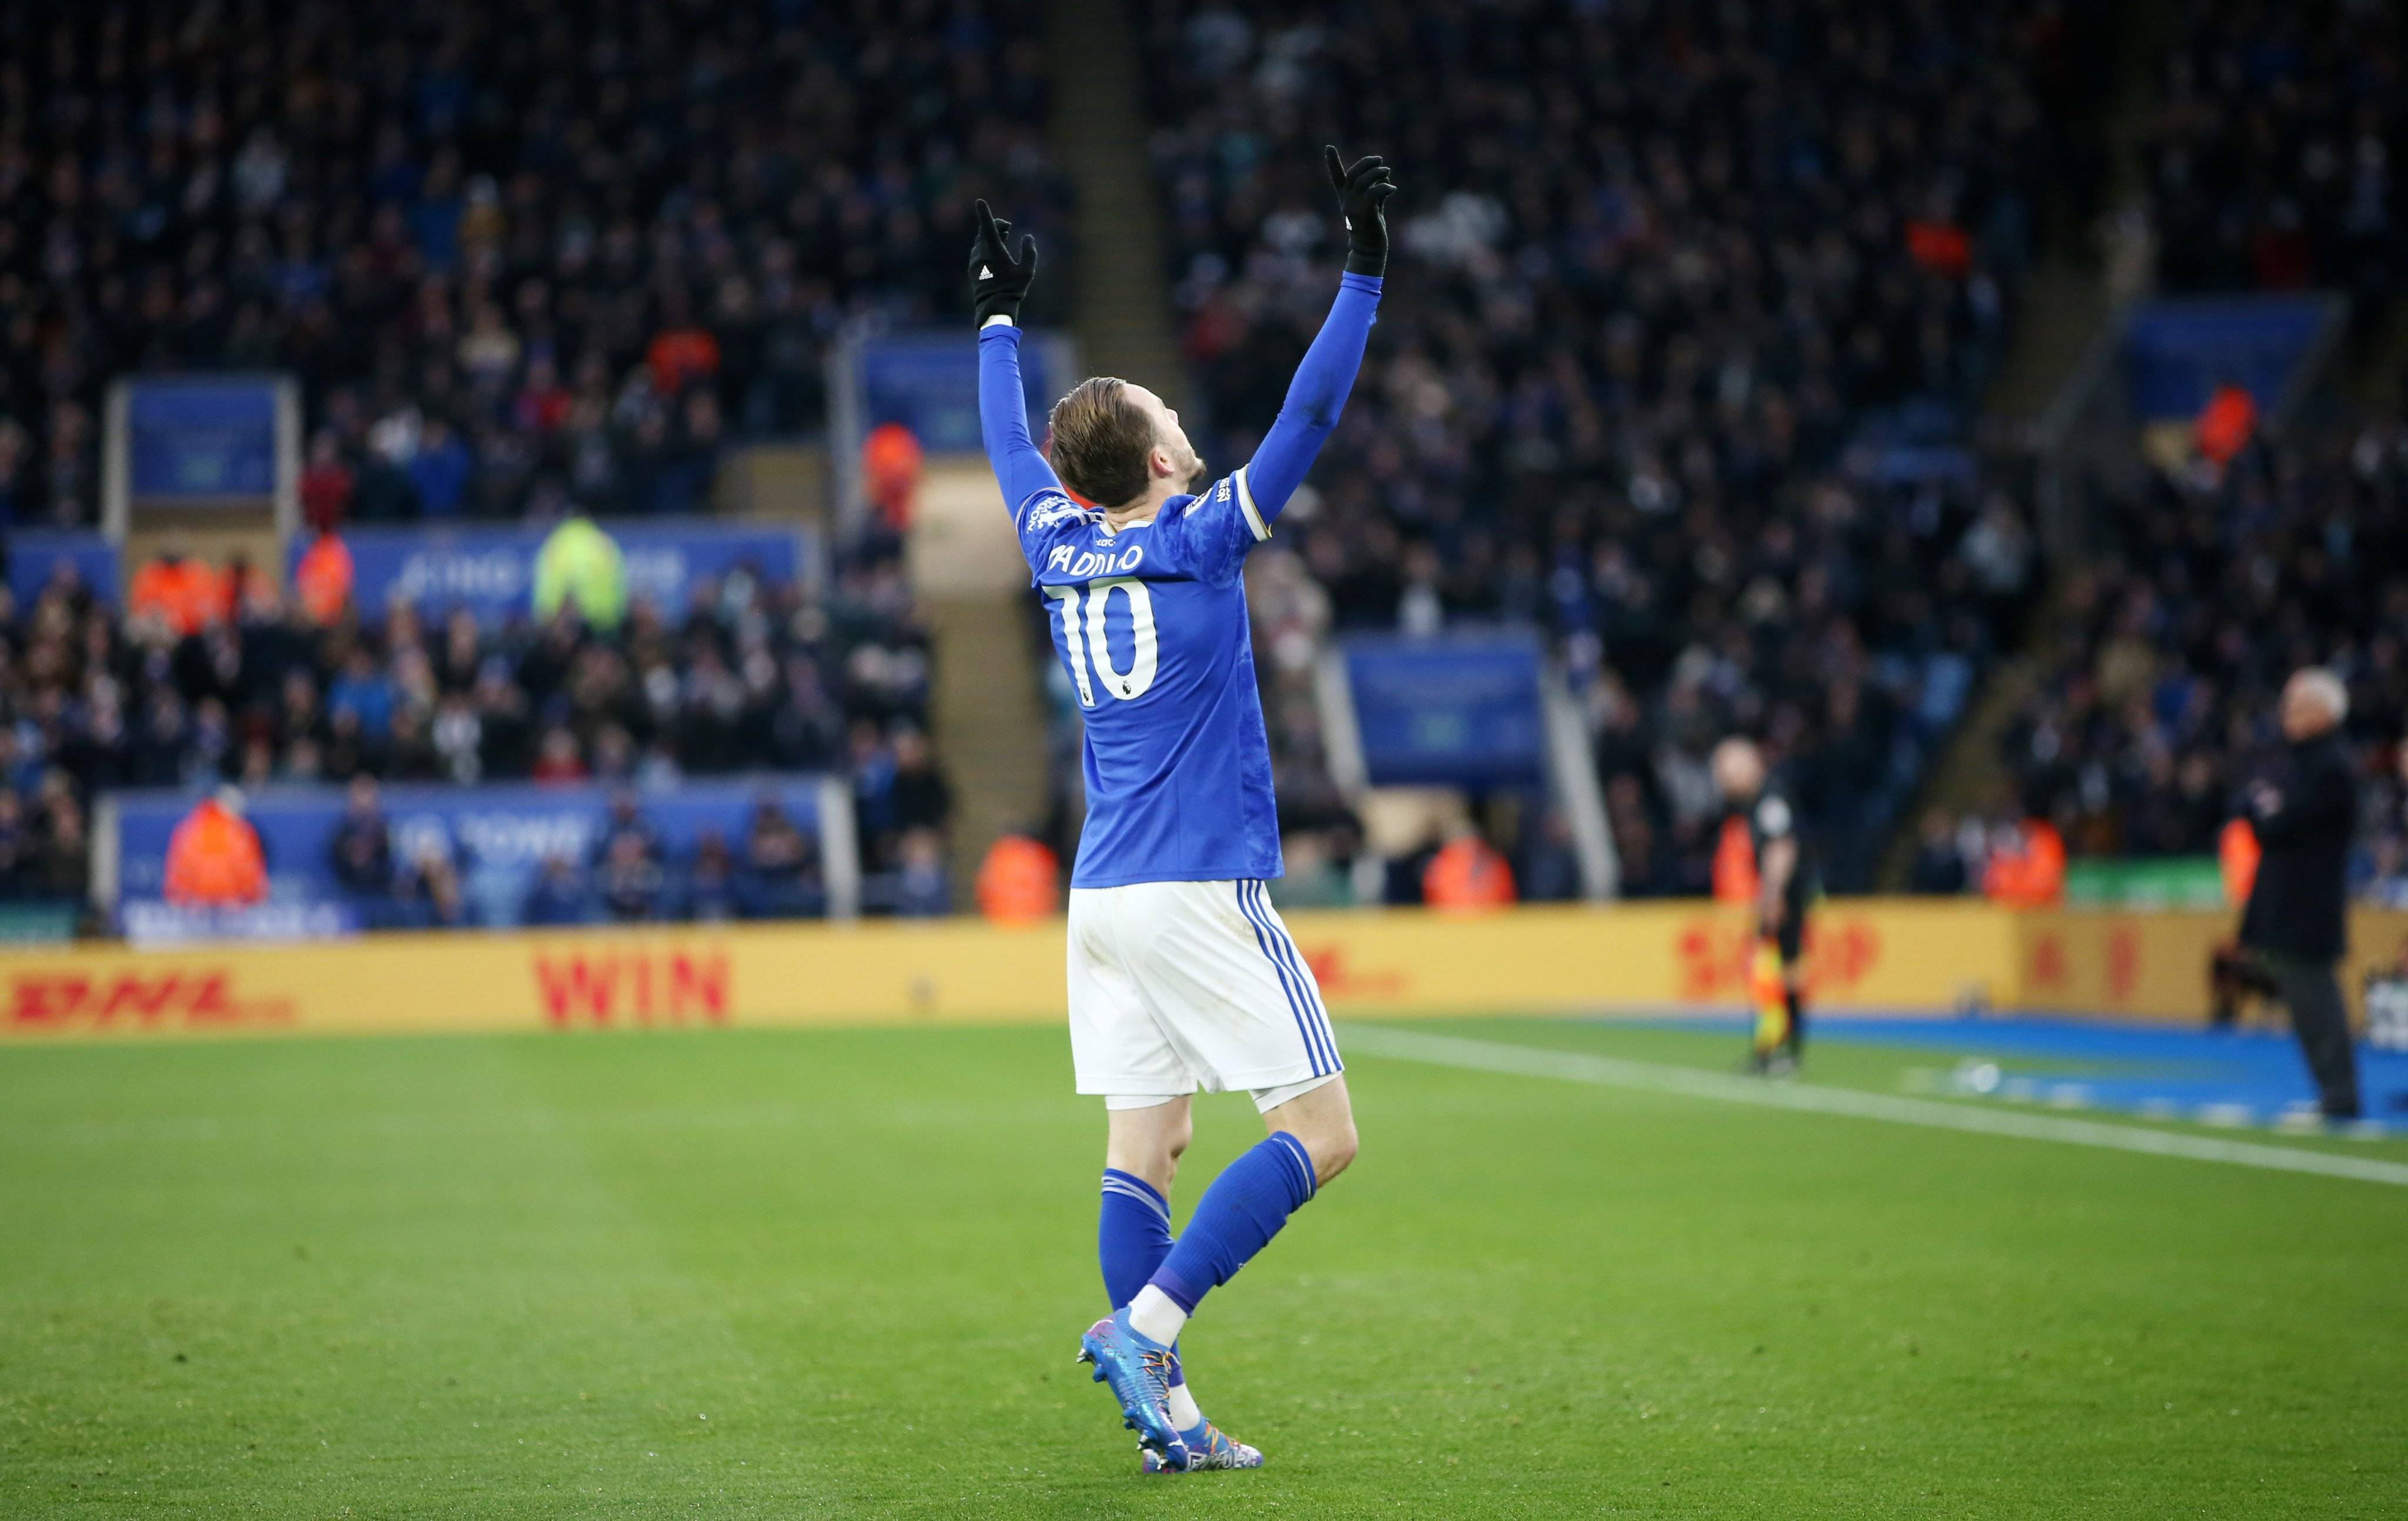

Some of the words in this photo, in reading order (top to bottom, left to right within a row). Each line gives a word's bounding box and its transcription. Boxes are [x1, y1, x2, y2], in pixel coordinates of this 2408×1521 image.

[1096, 539, 1114, 547] LCFC
[1042, 576, 1159, 708] 10
[11, 970, 230, 1030] DHL
[534, 953, 733, 1025] WIN
